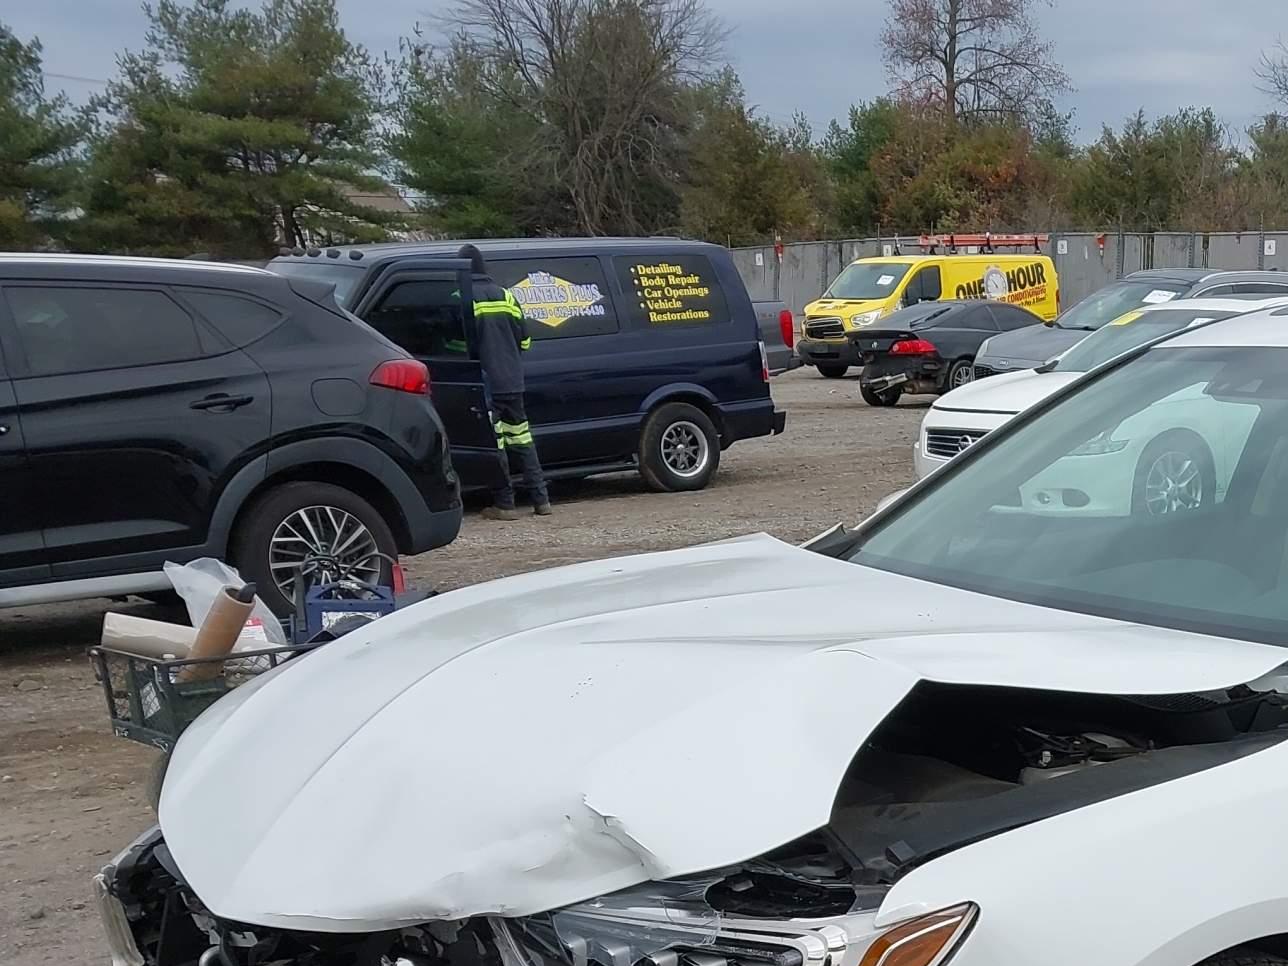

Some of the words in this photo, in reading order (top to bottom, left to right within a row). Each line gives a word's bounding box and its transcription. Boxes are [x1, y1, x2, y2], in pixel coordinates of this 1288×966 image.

[636, 263, 682, 275] Detailing
[640, 275, 666, 287] Body
[667, 274, 700, 286] Repair
[956, 279, 987, 299] ONE
[1006, 262, 1047, 292] HOUR
[568, 283, 601, 302] PLUS
[644, 288, 662, 298] Car
[664, 286, 709, 298] Openings
[646, 299, 682, 310] Vehicle
[649, 309, 709, 322] Restorations
